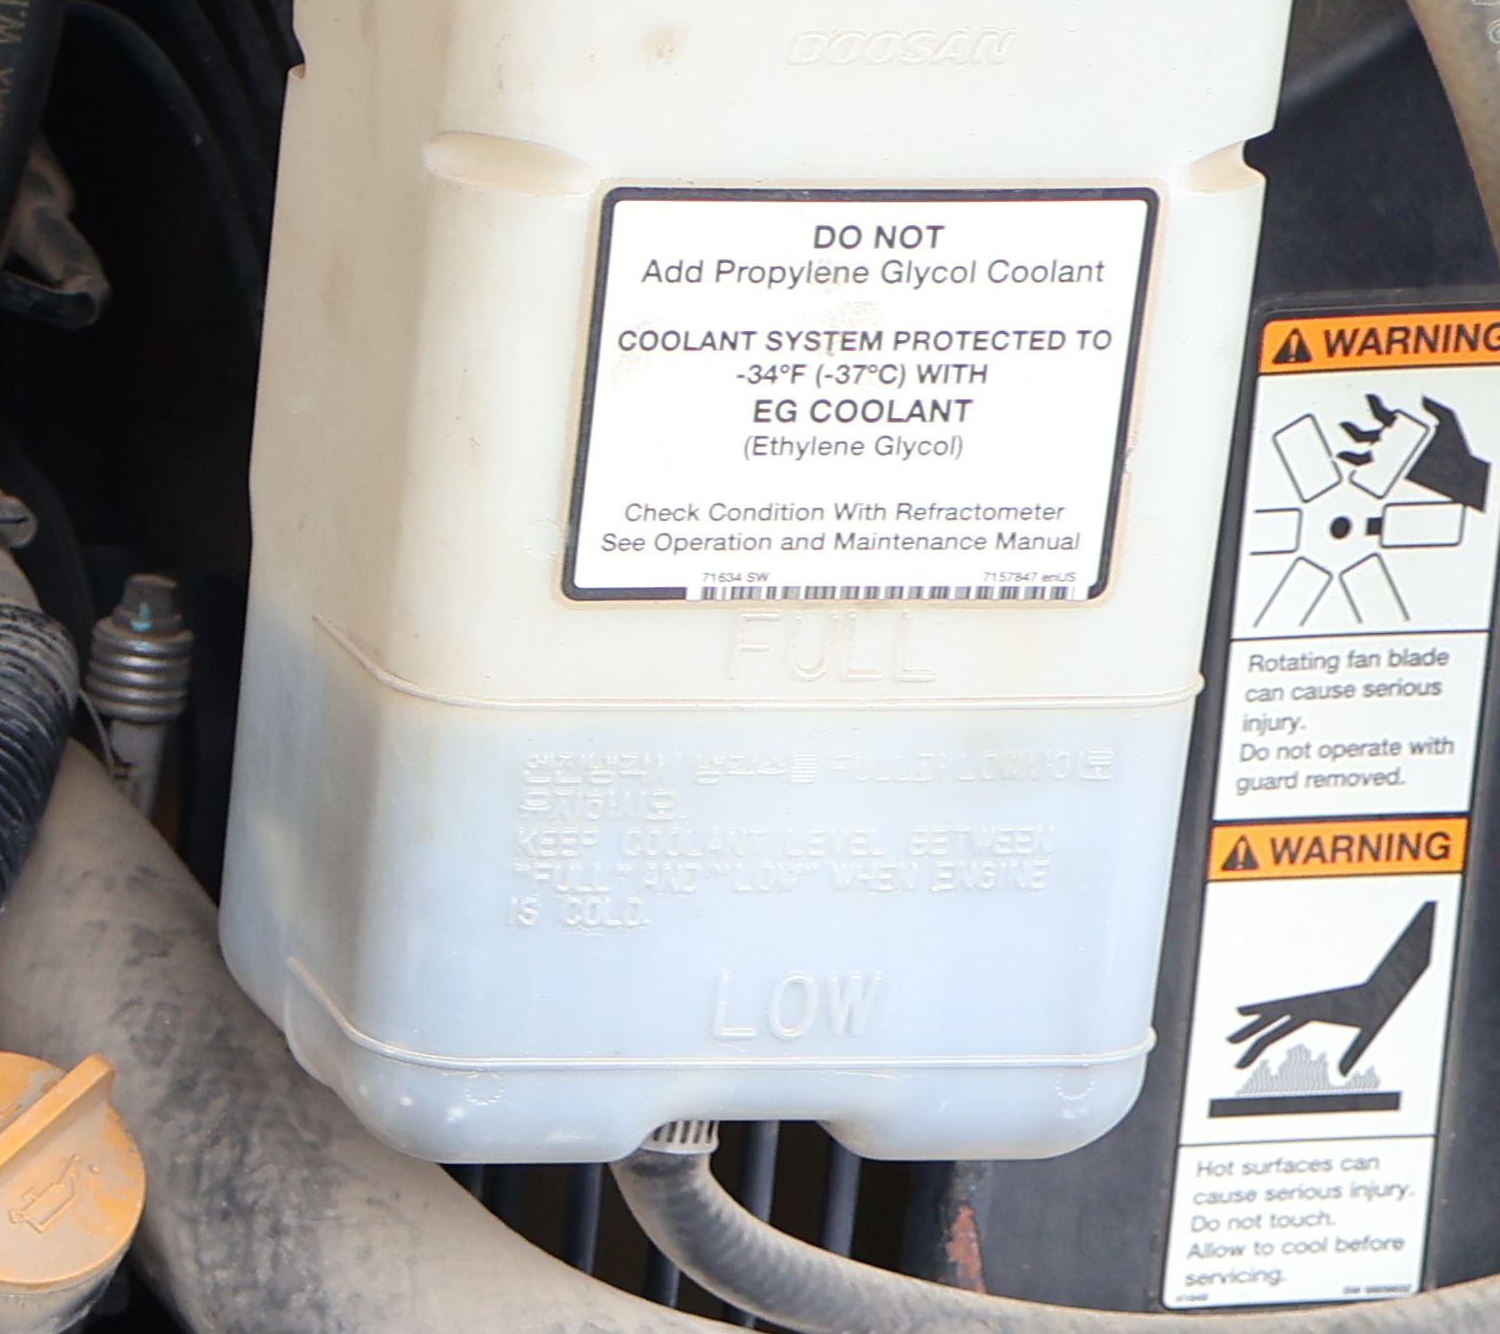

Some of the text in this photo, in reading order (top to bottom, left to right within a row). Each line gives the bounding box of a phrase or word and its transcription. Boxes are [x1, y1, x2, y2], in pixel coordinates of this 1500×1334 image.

[787, 25, 1018, 65] DOOSAN
[814, 225, 945, 249] DO NOT
[642, 259, 1104, 290] Add Propylene Glycol Coolant
[618, 330, 1112, 351] COOLANT SYSTEM PROTECTED TO
[1325, 322, 1500, 358] WARNING
[737, 364, 987, 388] -34°F (-37°C) WITH
[754, 399, 973, 423] EG COOLANT
[744, 435, 962, 461] (Ethylene Glycol)
[625, 503, 1065, 522] Check Condition With Refractometer
[602, 532, 1080, 555] See Operation and Maintenance Manual
[747, 572, 768, 582] SW
[726, 610, 937, 682] FULL
[1249, 647, 1449, 675] Rotating fan blade
[1245, 678, 1442, 703] can cause serious
[1243, 713, 1305, 736] injury.
[1240, 736, 1454, 762] Do not operate with
[1236, 767, 1405, 796] guard removed.
[516, 825, 1055, 858] KEEP COOLANT LEVEL BETWEEN
[1270, 832, 1452, 866] WARNING
[642, 861, 700, 895] AND
[830, 860, 918, 894] WHEN
[929, 858, 1051, 893] ENGINE
[509, 894, 542, 928] IS
[707, 969, 888, 1041] LOW
[1196, 1157, 1380, 1177] Hot surfaces can
[1193, 1181, 1414, 1206] cause serious injury.
[1191, 1210, 1335, 1233] Do not touch.
[1187, 1235, 1405, 1259] Allow to cool before
[1185, 1269, 1286, 1287] servicing.
